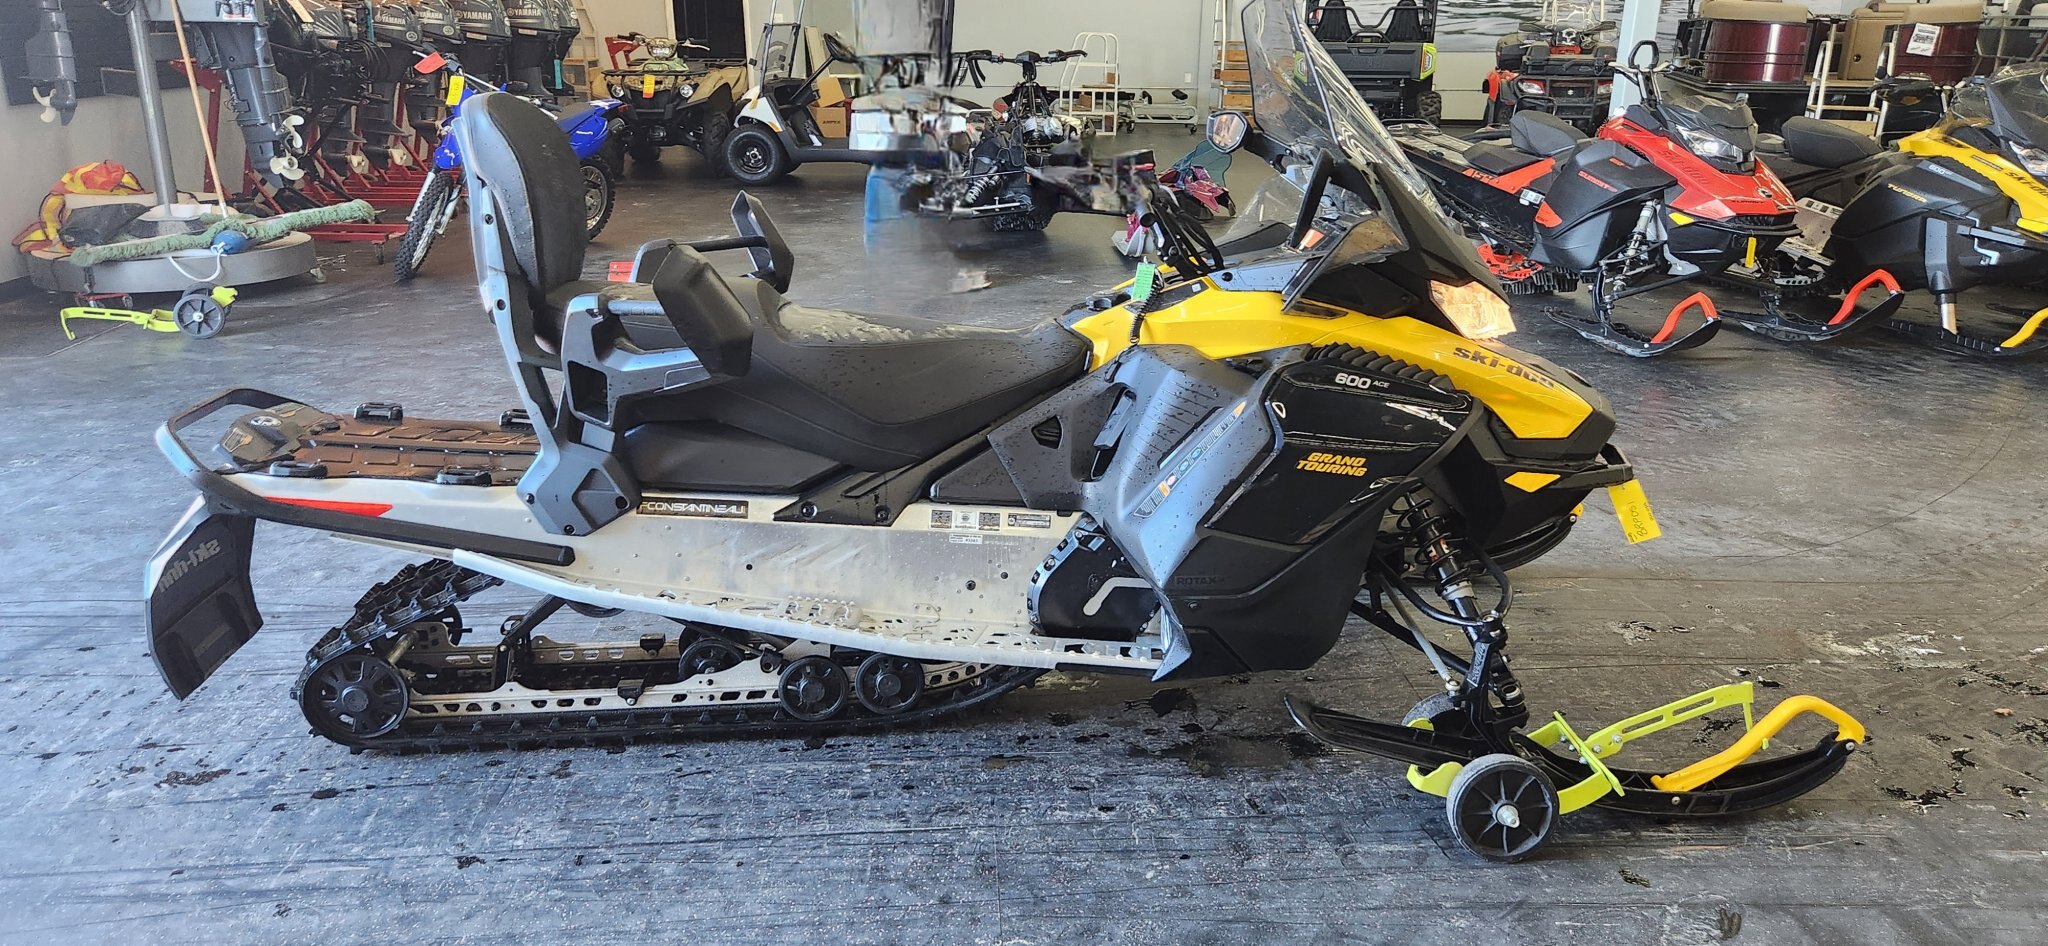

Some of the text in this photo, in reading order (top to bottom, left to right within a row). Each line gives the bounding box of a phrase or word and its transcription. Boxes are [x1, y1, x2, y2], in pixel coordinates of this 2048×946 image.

[418, 10, 443, 20] YAMAHA
[462, 10, 493, 21] YAMAHA
[514, 8, 542, 17] YAMAHA
[381, 15, 406, 25] YAMAHA
[1335, 372, 1391, 389] 600 ACE
[1307, 452, 1367, 467] GRAND
[1296, 460, 1368, 477] TOURING
[1175, 575, 1217, 585] ROTAX
